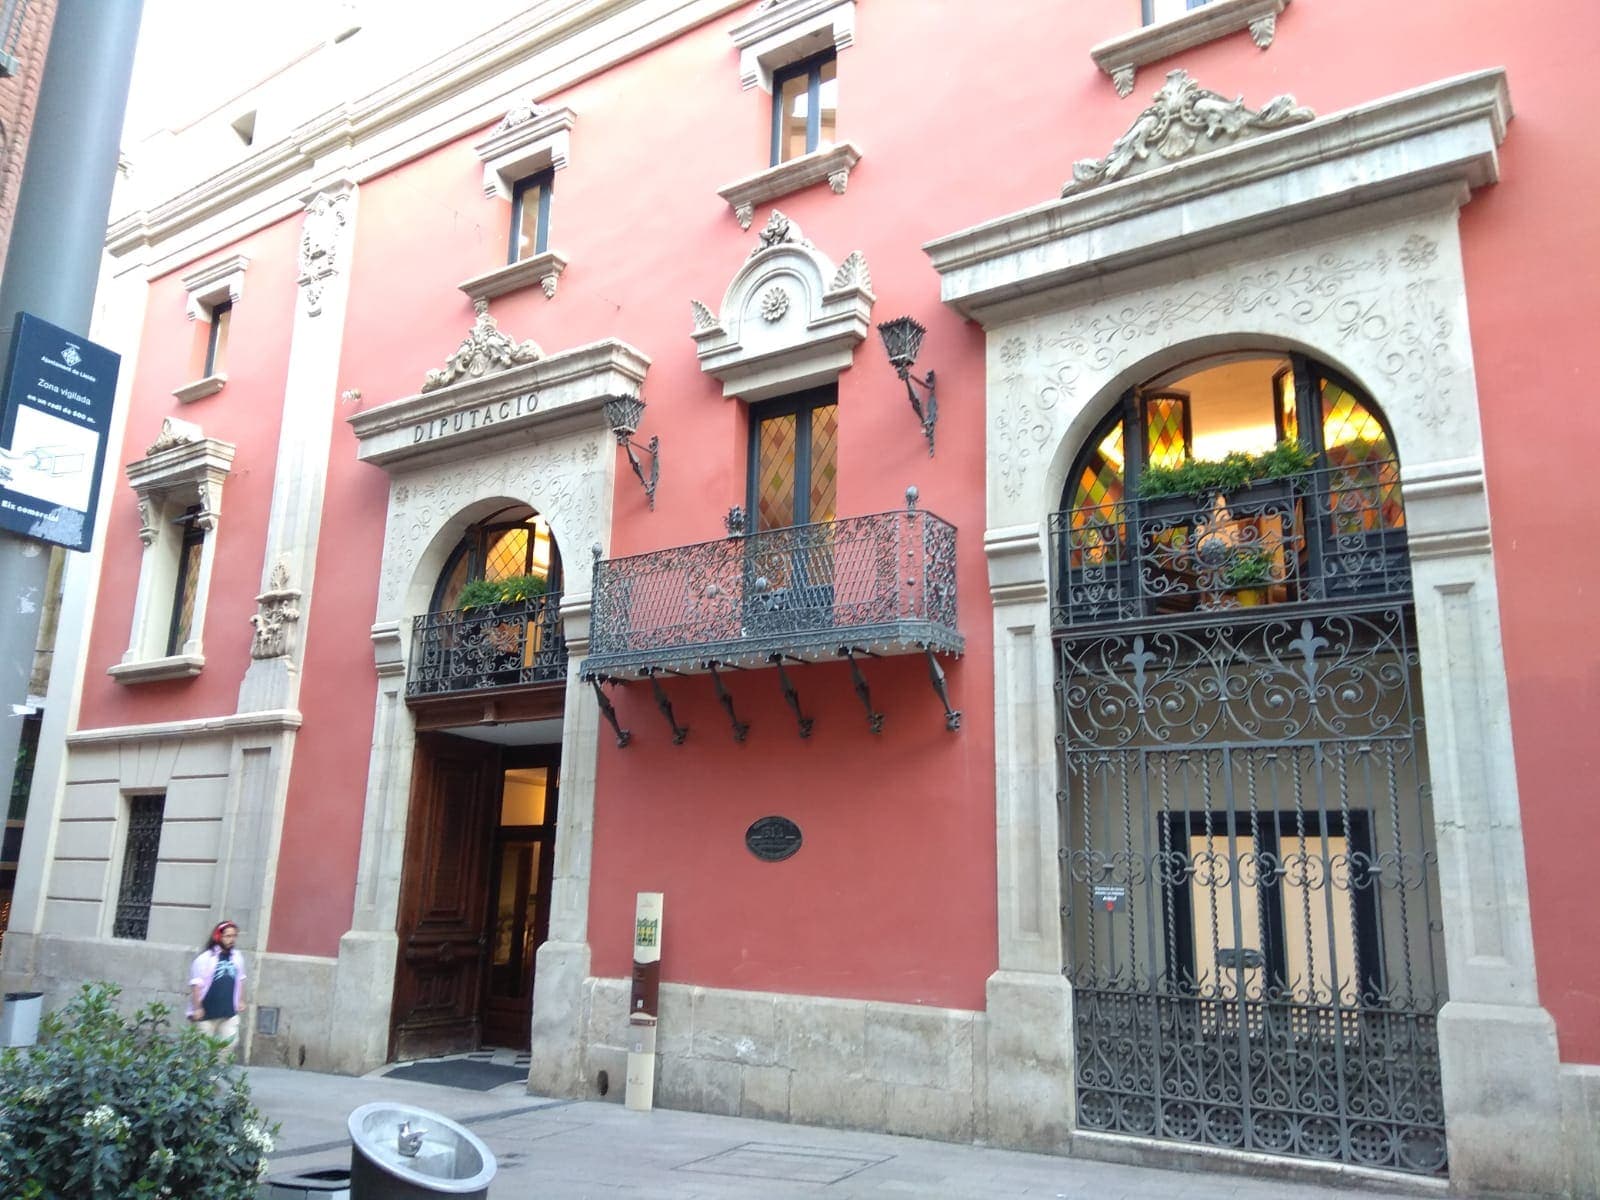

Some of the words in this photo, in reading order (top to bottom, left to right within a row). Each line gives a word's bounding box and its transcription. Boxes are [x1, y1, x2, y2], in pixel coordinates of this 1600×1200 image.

[37, 378, 59, 393] Zona
[61, 388, 91, 406] vigilada
[47, 402, 62, 411] radi
[62, 407, 72, 415] de
[1, 500, 16, 510] Eix
